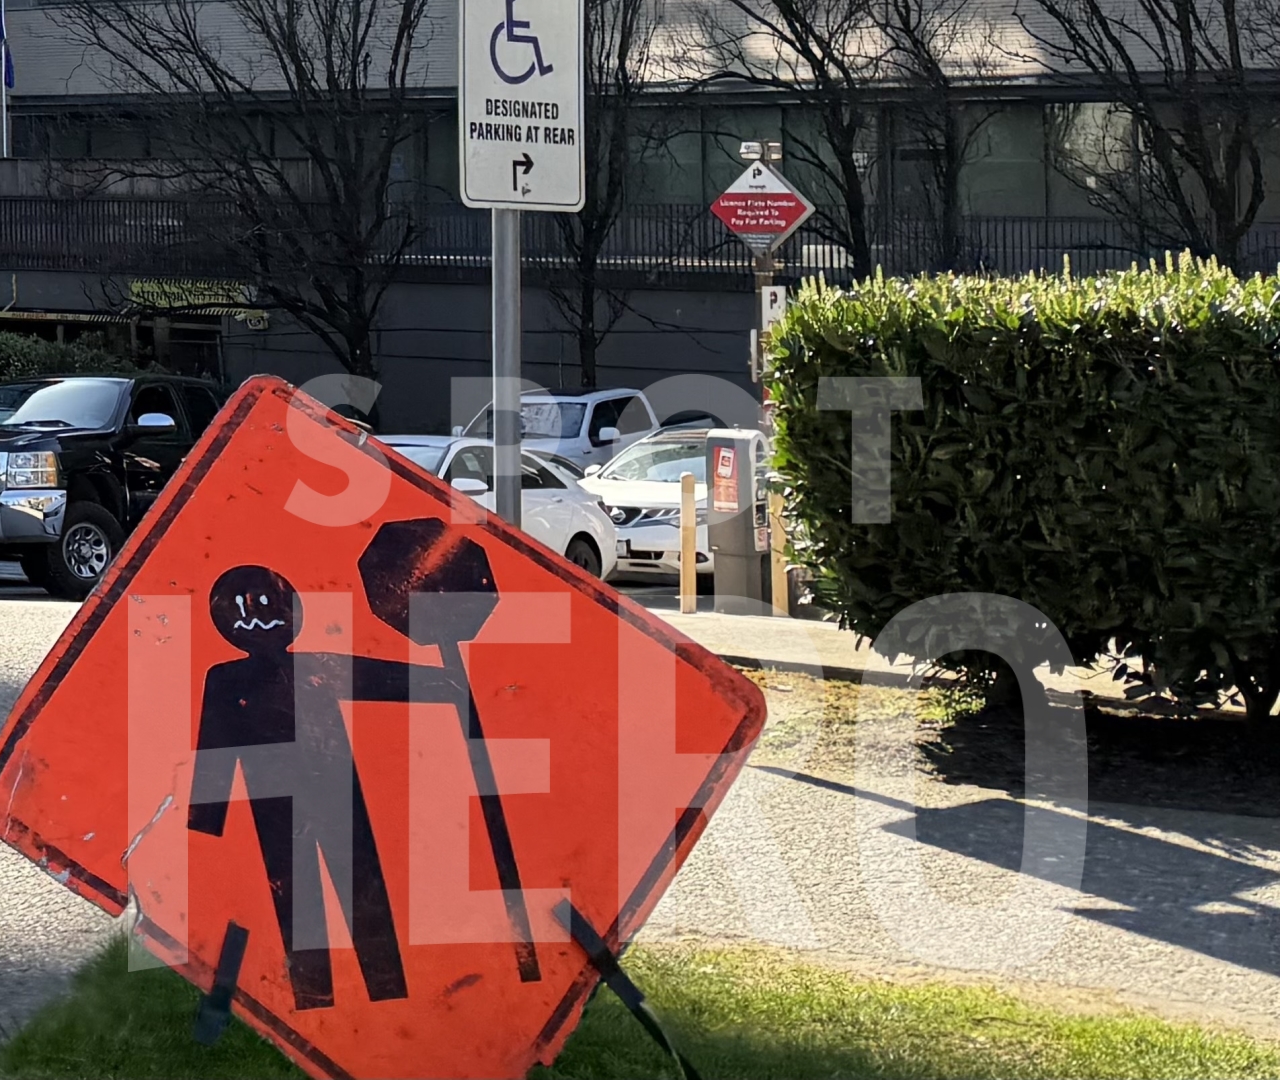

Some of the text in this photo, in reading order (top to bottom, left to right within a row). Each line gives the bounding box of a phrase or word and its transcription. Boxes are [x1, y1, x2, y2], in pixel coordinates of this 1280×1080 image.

[485, 98, 559, 120] DESIGNATED
[469, 121, 575, 146] PARKING AT REAR
